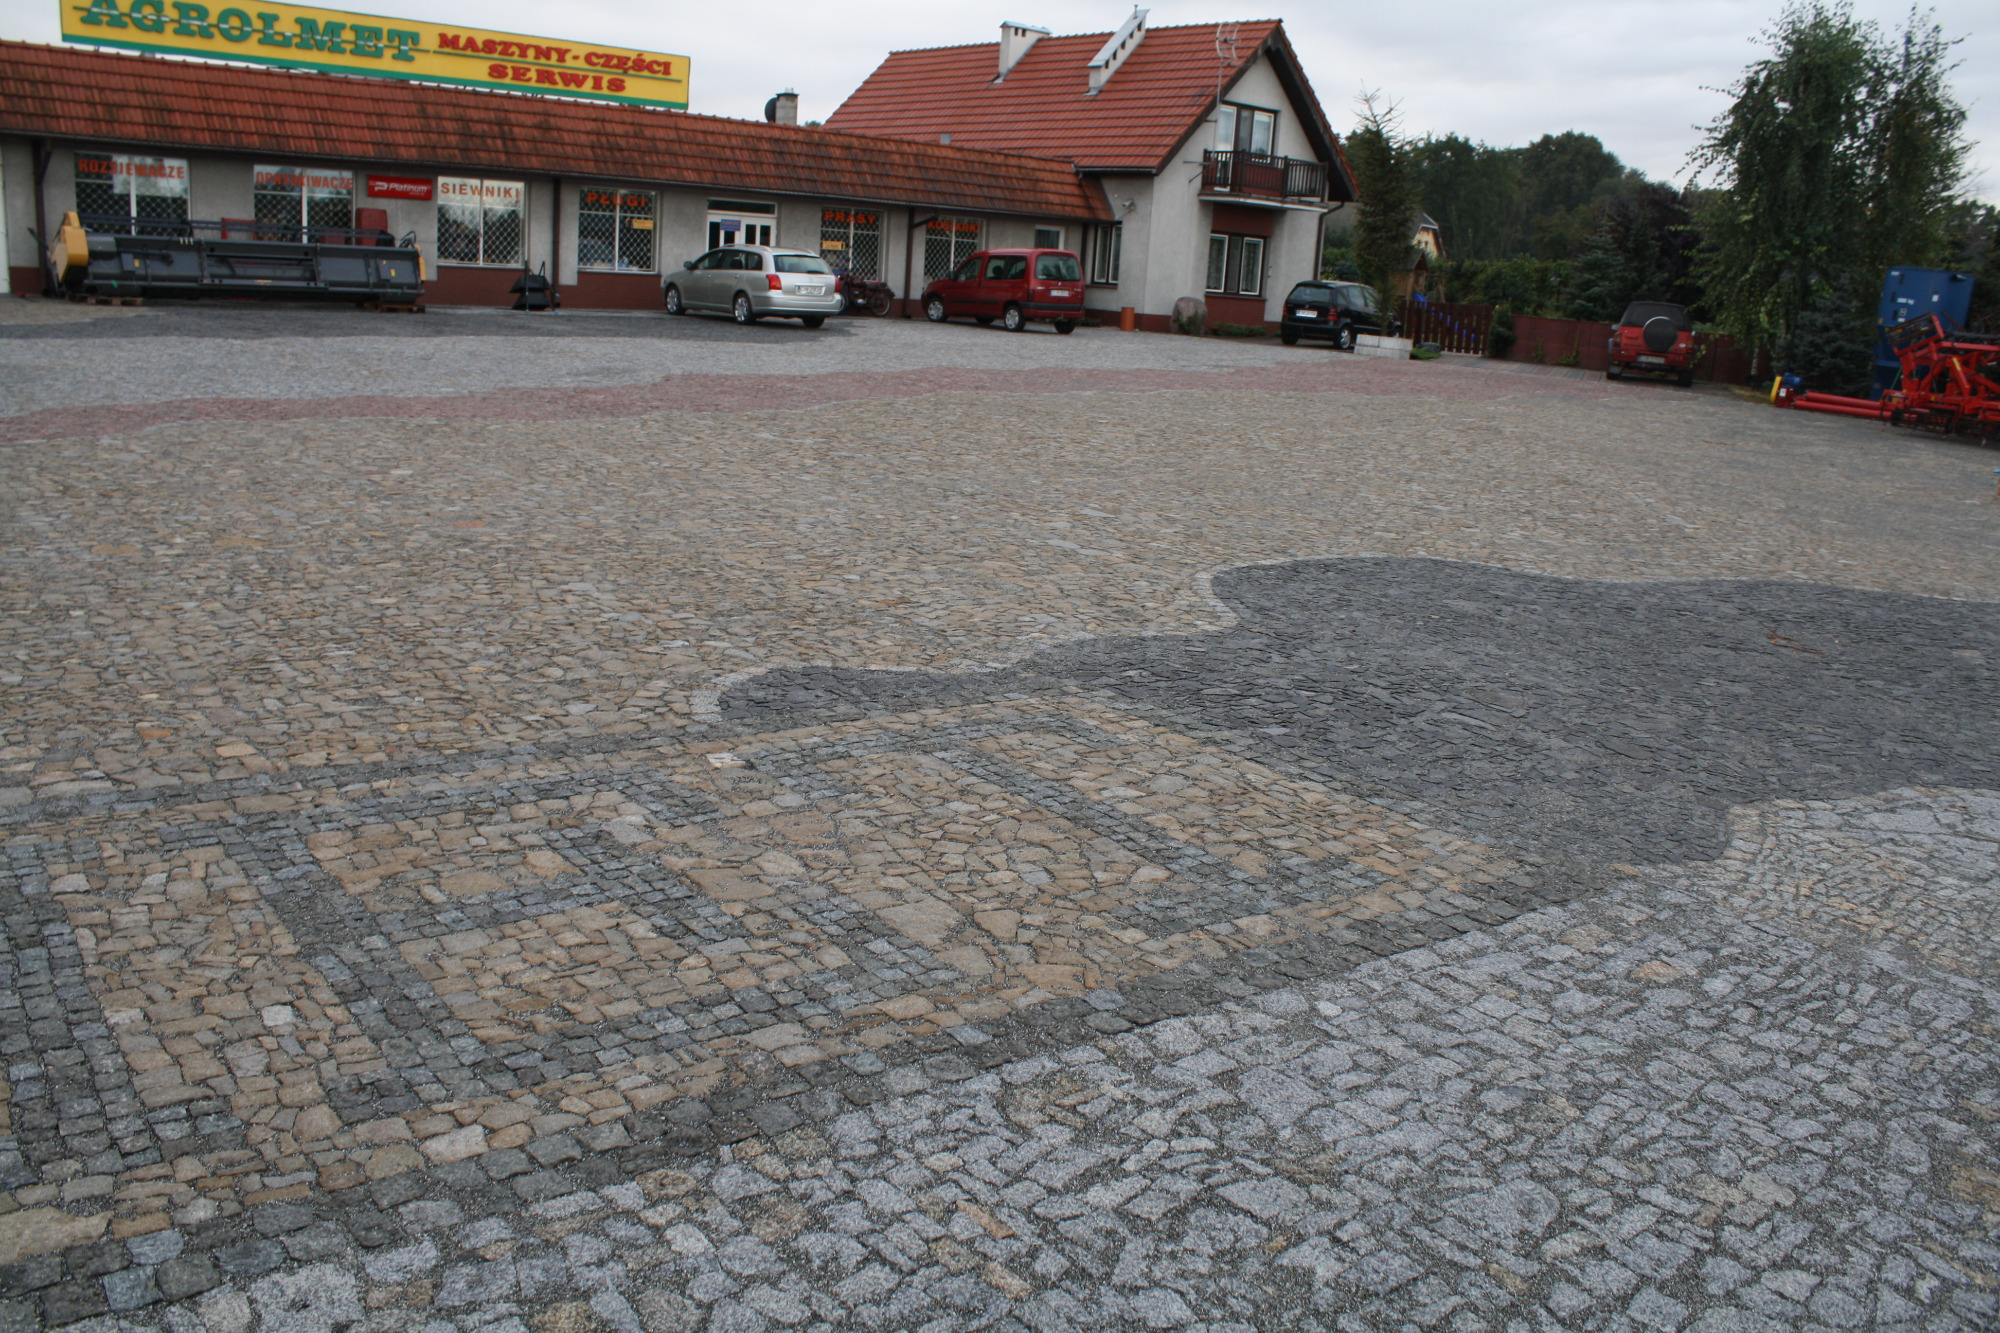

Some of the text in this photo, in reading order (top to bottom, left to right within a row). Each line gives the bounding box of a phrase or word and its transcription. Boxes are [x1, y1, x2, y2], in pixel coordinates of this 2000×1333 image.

[80, 0, 420, 62] AGROLMET
[438, 32, 572, 63] MASZYNY
[584, 52, 672, 76] CZĘŚCI
[488, 63, 627, 92] SERWIS
[78, 158, 185, 179] ROZSIEWACZE
[256, 171, 353, 190] OPRYSKIWACZE
[389, 182, 428, 193] Platinum
[440, 182, 521, 199] SIEWNIKI
[586, 191, 647, 207] PŁUGI
[824, 210, 877, 225] PRASY
